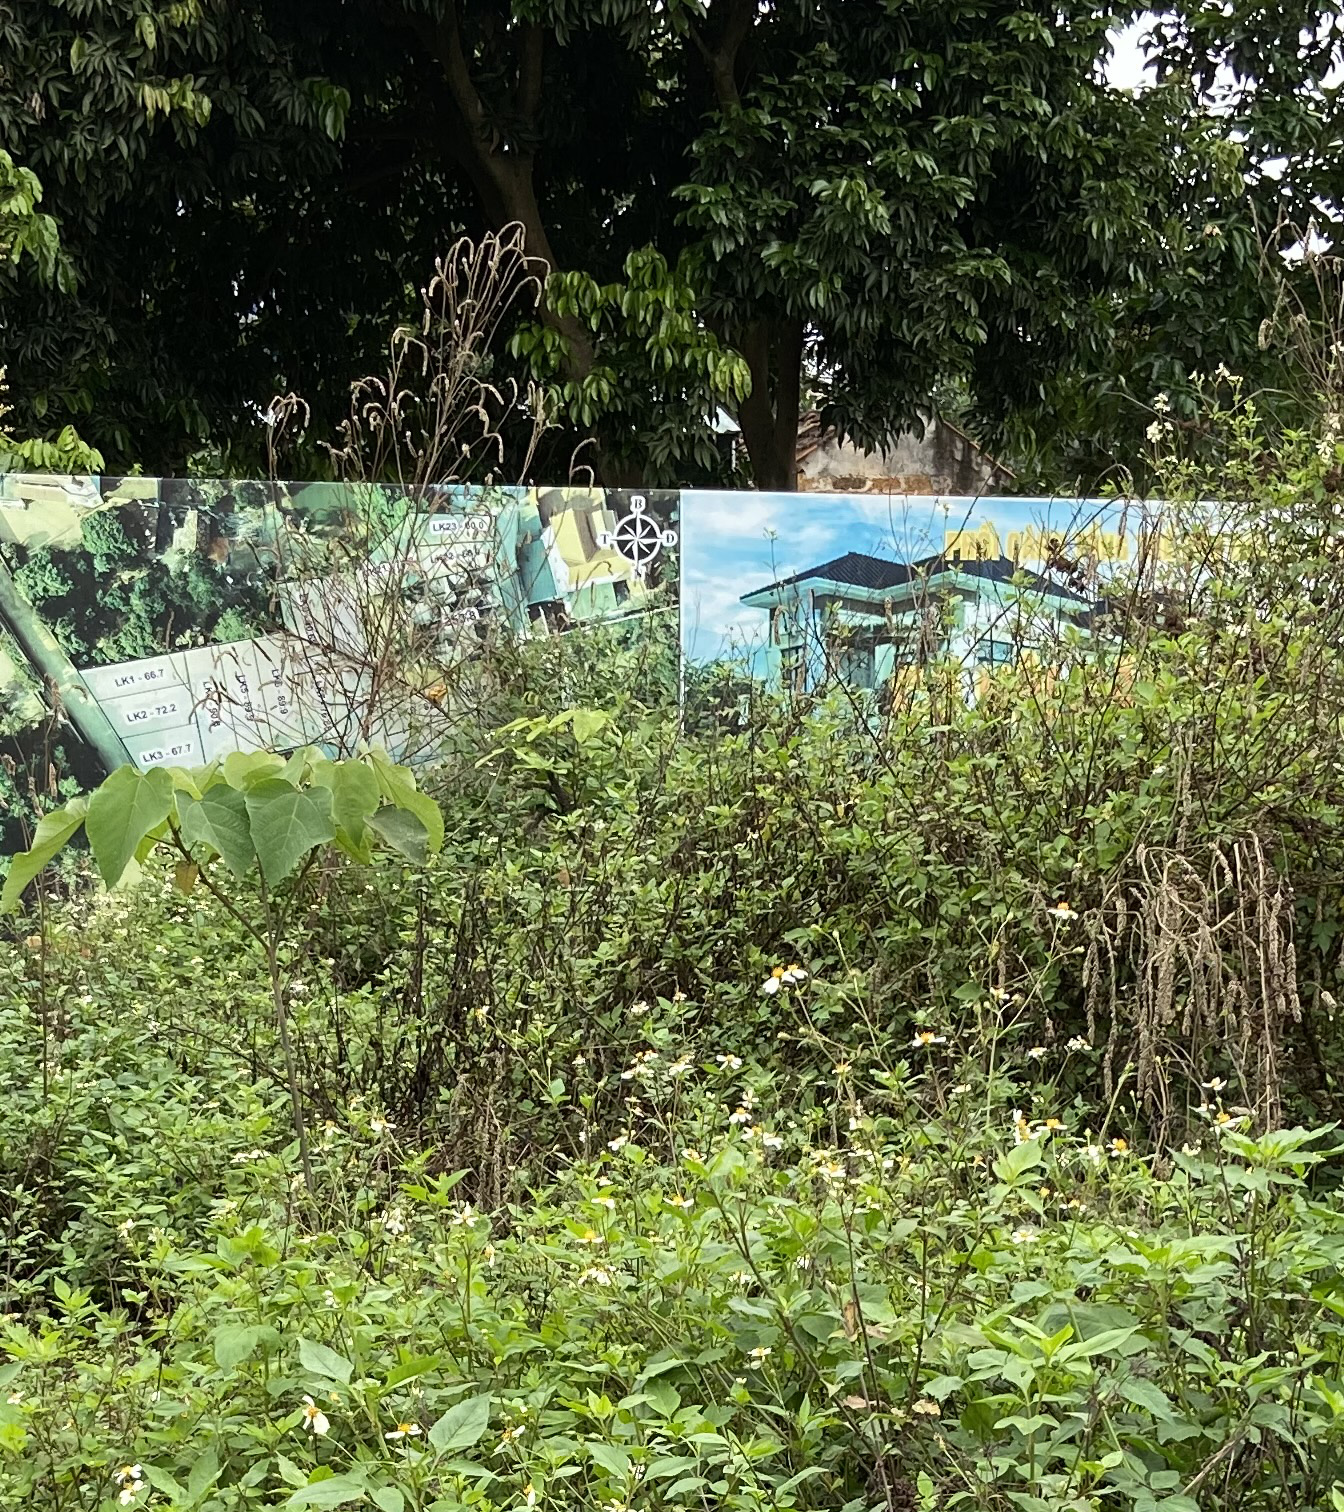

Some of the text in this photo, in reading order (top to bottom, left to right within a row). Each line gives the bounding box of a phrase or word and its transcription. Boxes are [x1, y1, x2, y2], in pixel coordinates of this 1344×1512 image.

[114, 674, 135, 687] LK1
[144, 669, 164, 682] 66.7
[126, 711, 147, 723] LK2
[156, 704, 177, 716] 72.2
[142, 750, 164, 763] LK3
[171, 744, 191, 756] 67.7
